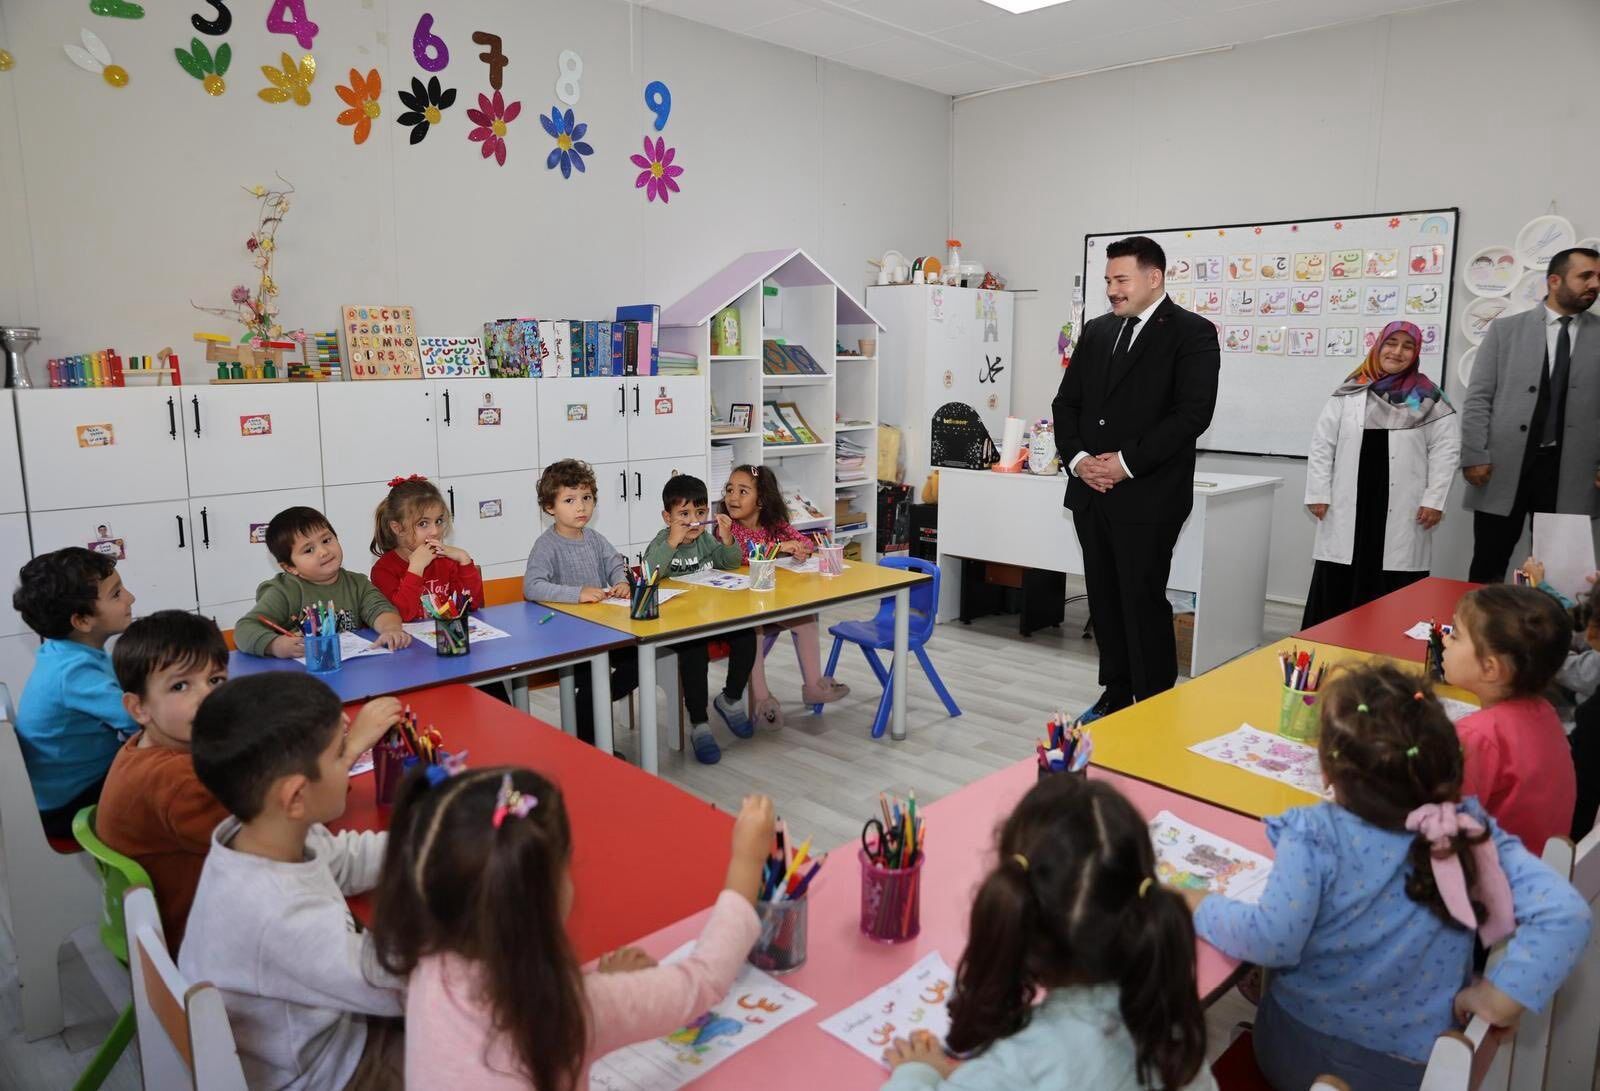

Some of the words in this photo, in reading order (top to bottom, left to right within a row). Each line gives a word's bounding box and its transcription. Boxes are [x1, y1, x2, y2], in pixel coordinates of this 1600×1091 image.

[267, 0, 319, 49] 4
[413, 13, 449, 72] 6
[472, 31, 509, 90] 7
[556, 51, 583, 105] 8
[645, 81, 671, 131] 9
